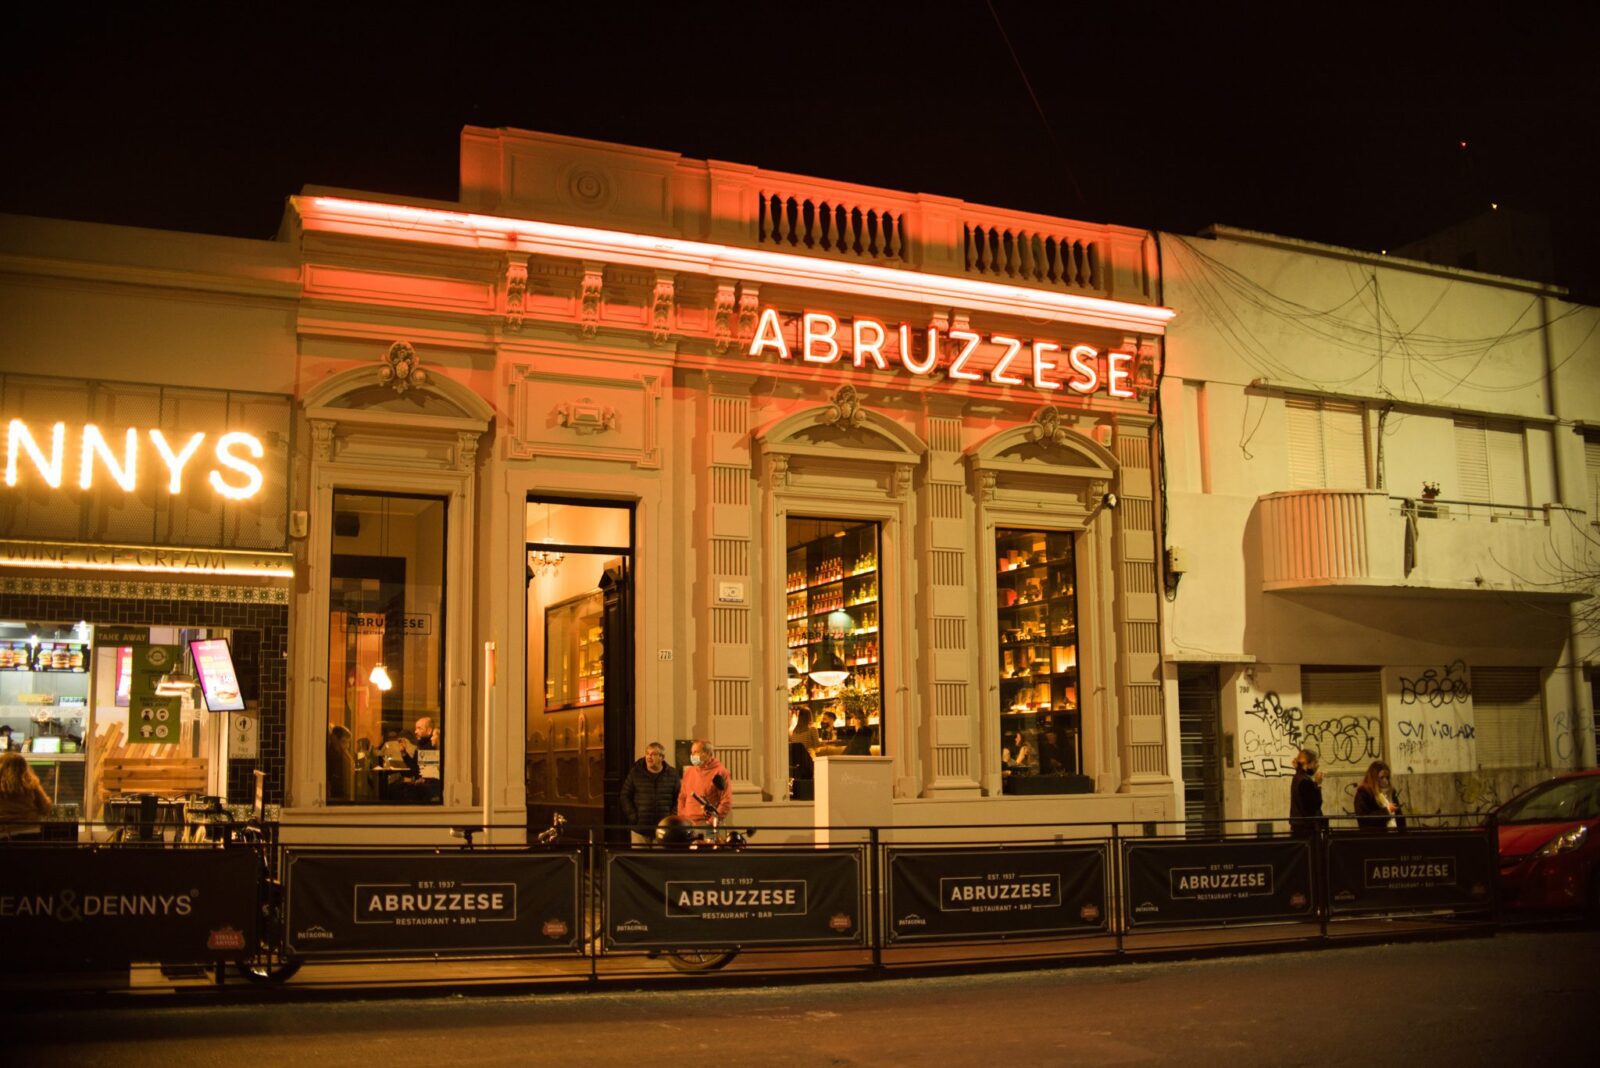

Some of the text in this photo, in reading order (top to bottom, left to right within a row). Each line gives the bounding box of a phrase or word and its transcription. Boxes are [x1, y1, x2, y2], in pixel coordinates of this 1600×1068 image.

[748, 307, 1136, 399] ABRUZZESE
[5, 418, 265, 500] NNYS
[348, 617, 425, 629] ABRUESE
[123, 633, 147, 642] AWAY
[1372, 864, 1449, 880] ABRUZZESE
[1179, 873, 1266, 890] ABRUZZESE
[678, 889, 796, 907] ABRUZZESE
[951, 883, 1051, 901] ABRUZZESE
[368, 893, 504, 912] ABRUZZESE
[971, 904, 1012, 913] RESTAURANT
[395, 917, 477, 926] RESTAURANT BAR
[702, 911, 773, 919] RESTAURANT BAR
